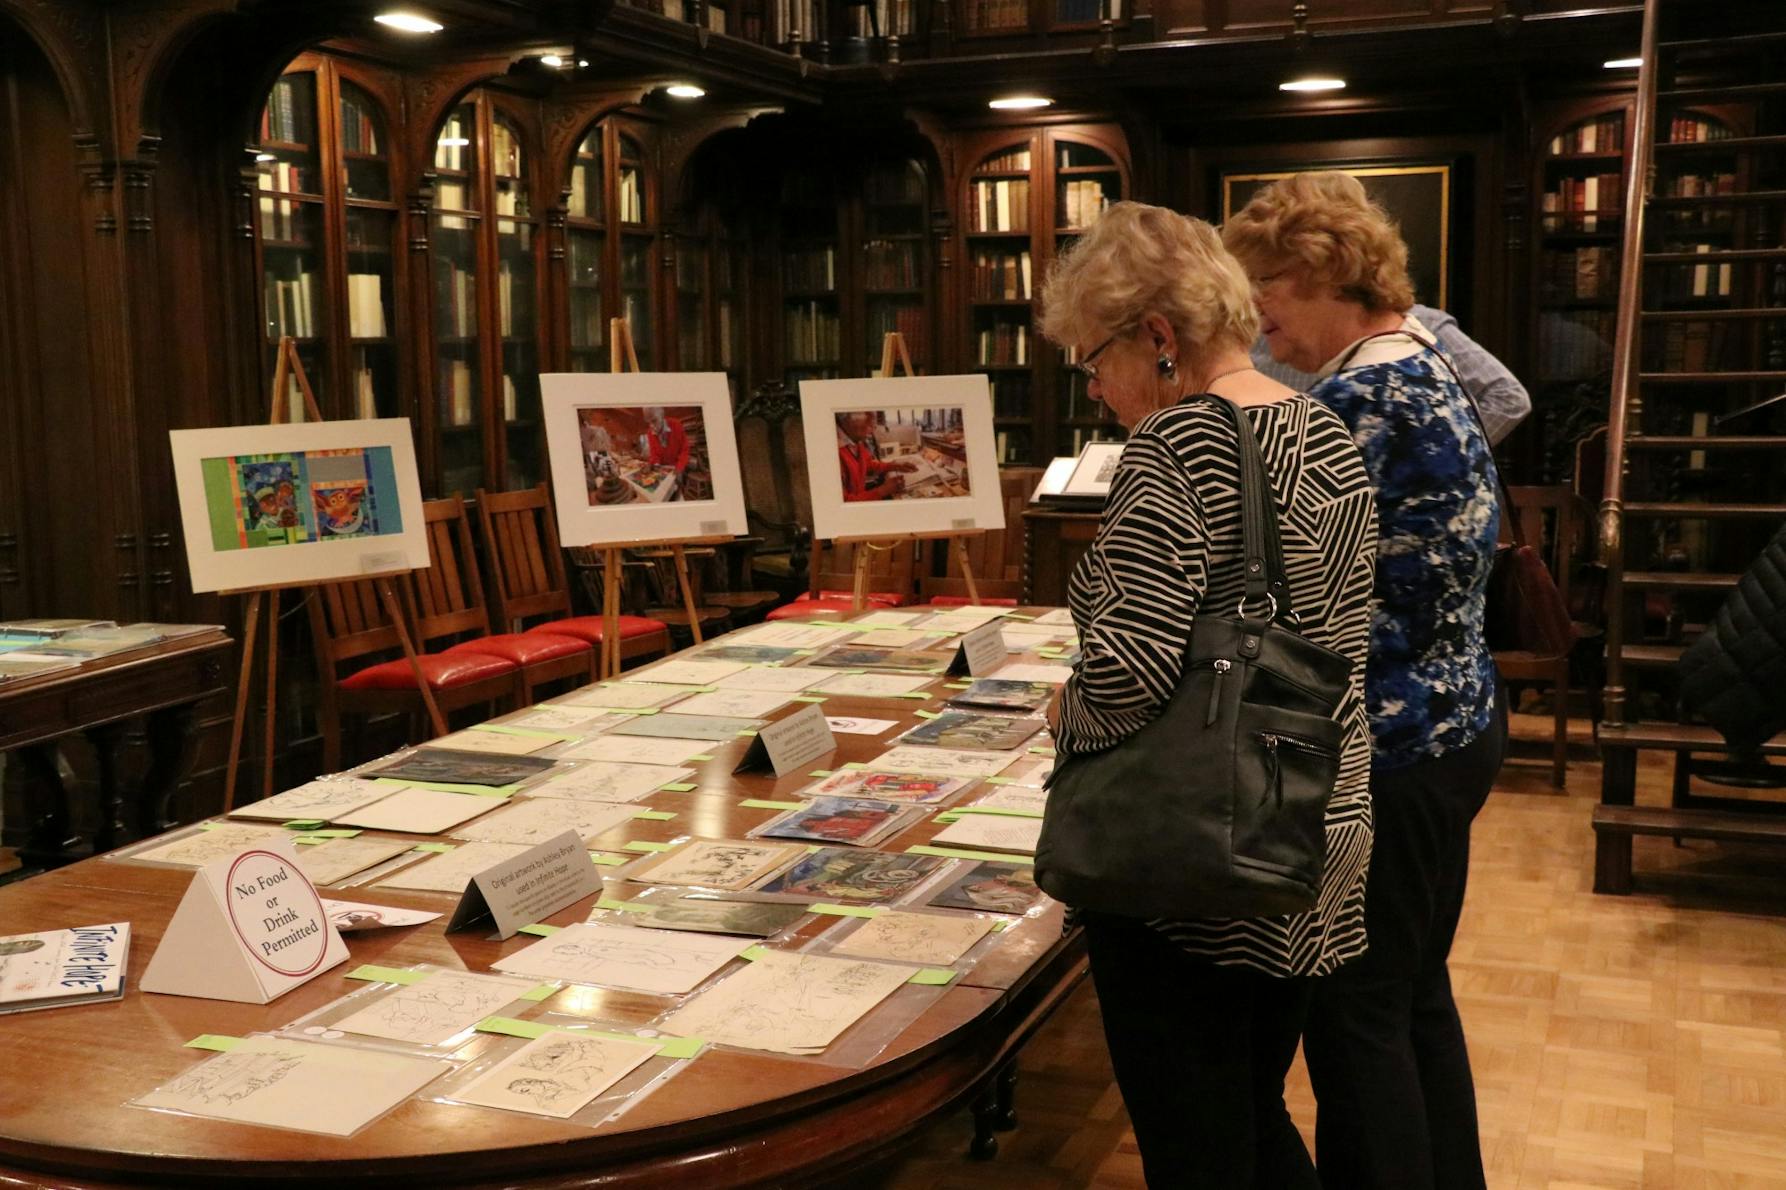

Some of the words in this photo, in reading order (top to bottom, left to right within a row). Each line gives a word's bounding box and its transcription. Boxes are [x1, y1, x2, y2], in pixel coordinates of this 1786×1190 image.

[234, 883, 257, 900] No
[256, 866, 289, 891] Food
[491, 872, 514, 889] Original
[515, 863, 535, 879] artwork
[535, 859, 545, 870] by
[544, 850, 561, 864] Ashley
[560, 844, 576, 858] Bryan
[516, 882, 530, 895] used
[537, 869, 554, 885] Infinite
[554, 863, 569, 876] Hope
[266, 895, 279, 910] or
[262, 907, 300, 933] Drink
[261, 918, 320, 957] Permitted
